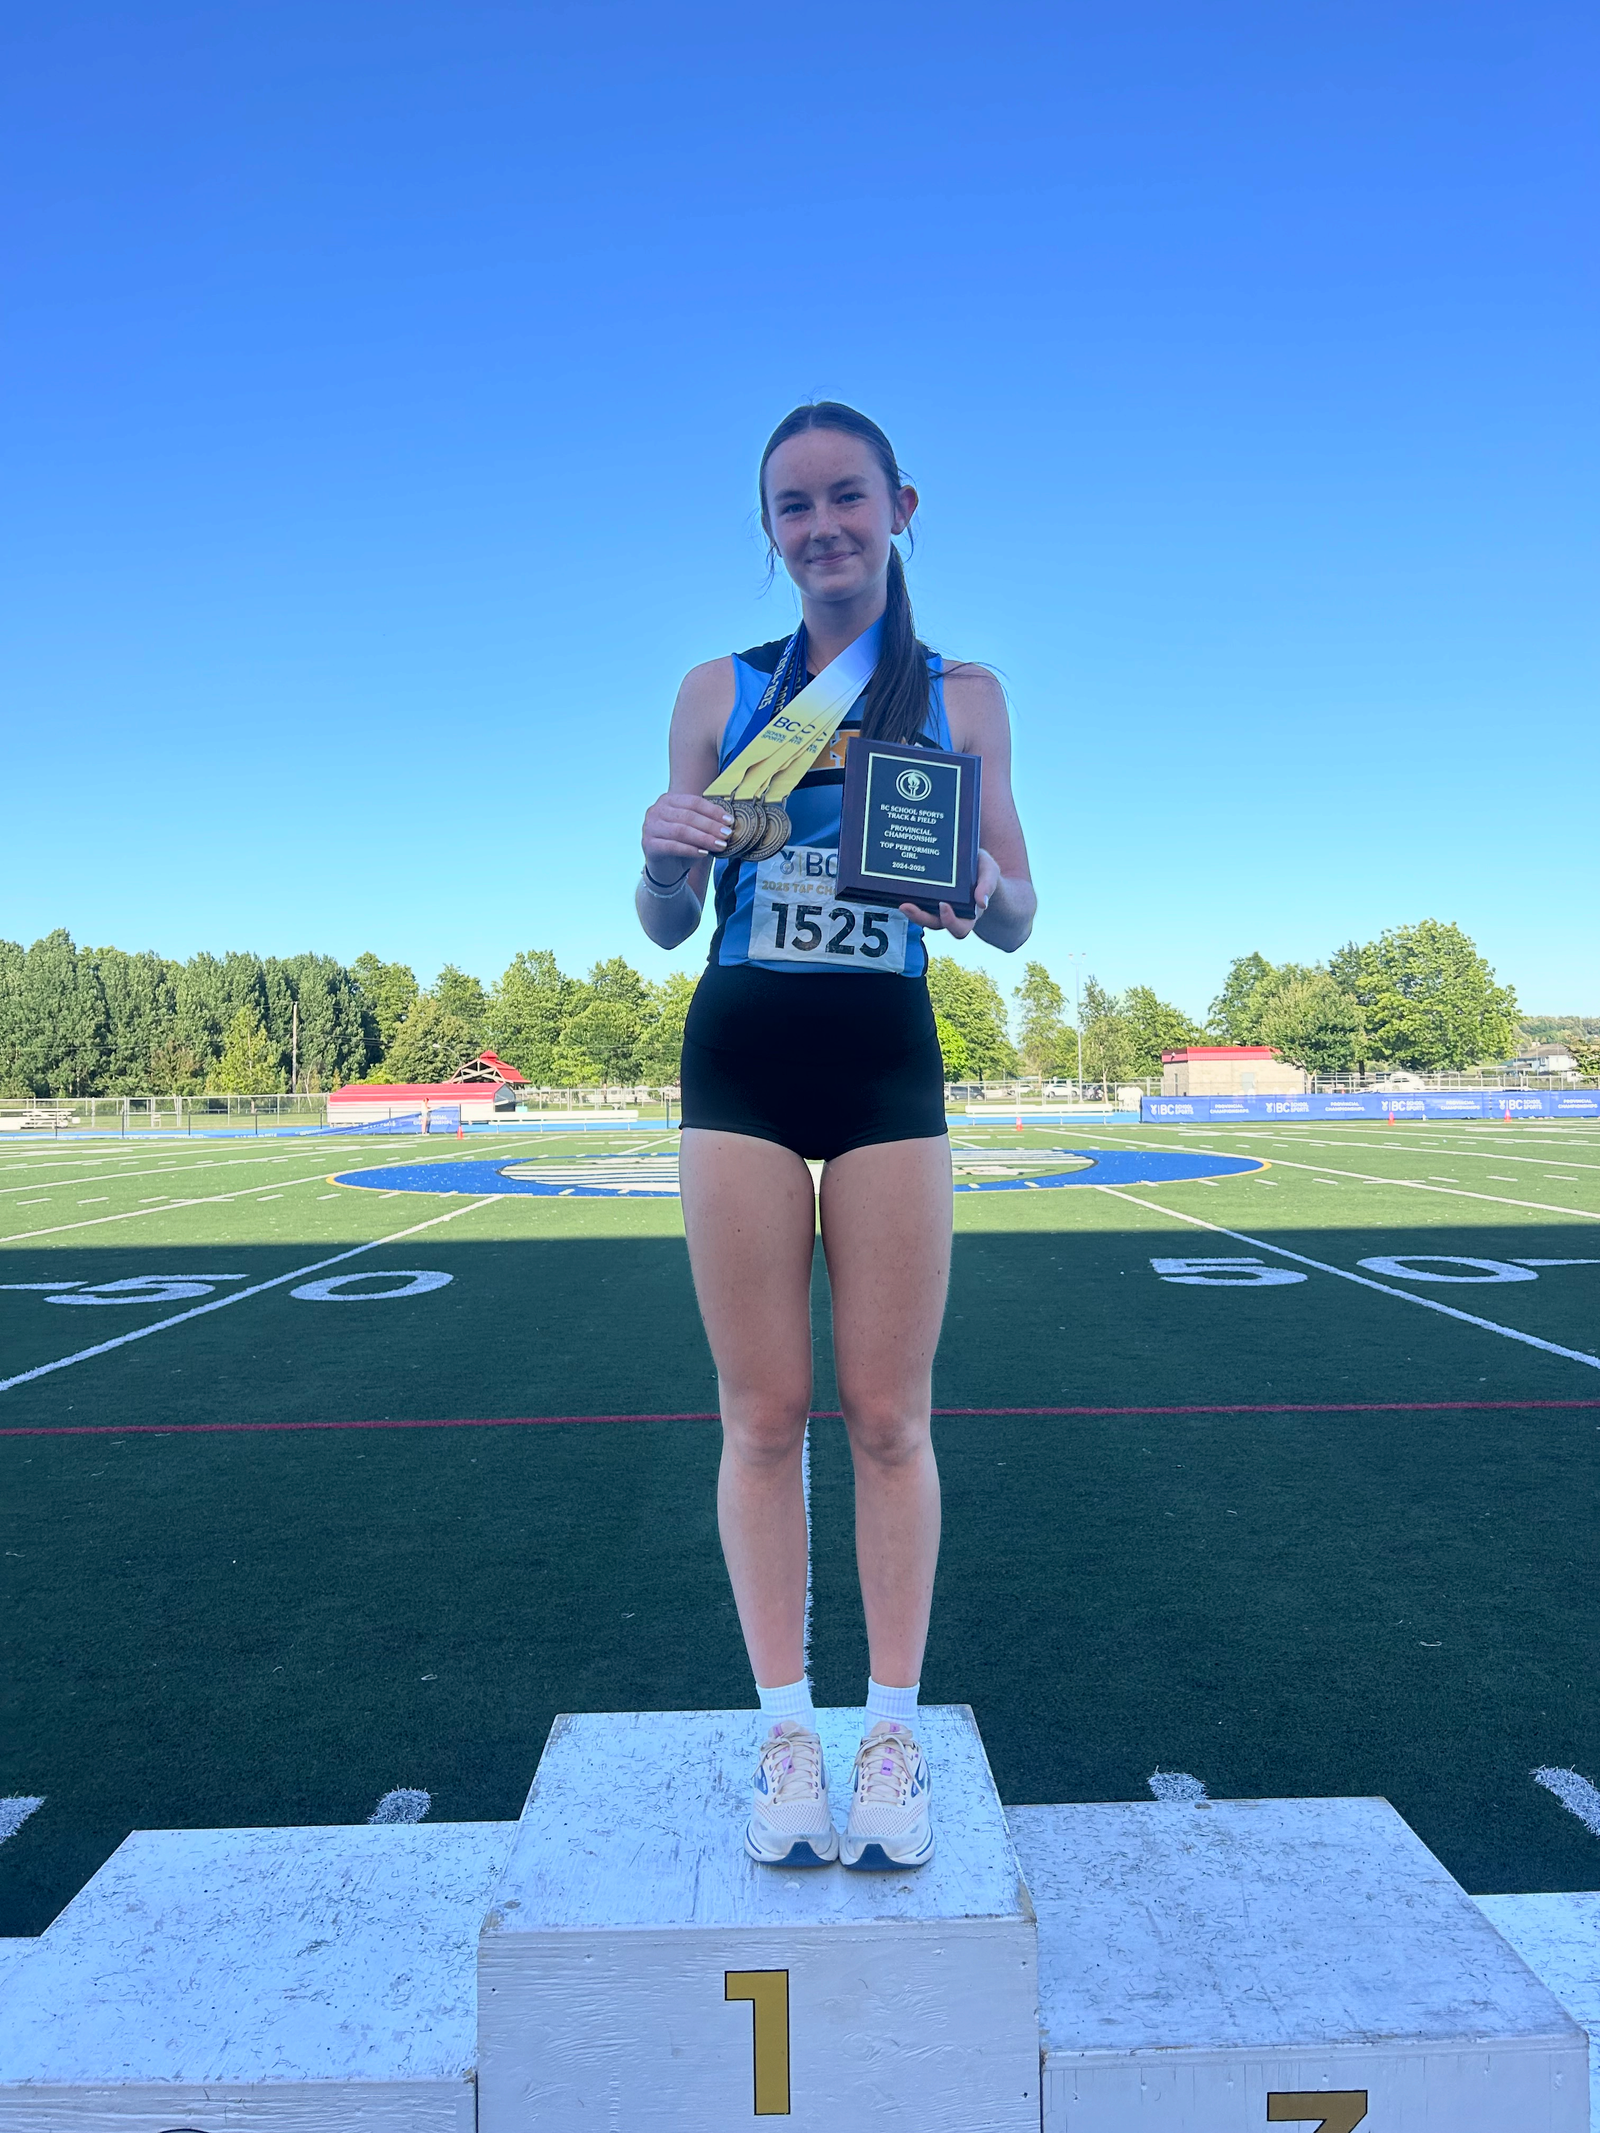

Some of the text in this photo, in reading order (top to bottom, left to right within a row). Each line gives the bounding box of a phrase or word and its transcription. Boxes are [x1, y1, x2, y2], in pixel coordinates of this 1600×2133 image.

[772, 716, 801, 732] BC
[887, 812, 910, 821] TRACK
[917, 816, 937, 825] FIELD
[890, 805, 918, 815] SCHOOL
[918, 809, 944, 819] SPORTS
[890, 824, 932, 836] PROVINCIAL
[884, 830, 938, 844] CHAMPIONSHIP
[880, 841, 940, 856] TOP PERFORMING
[901, 851, 918, 860] GIRL
[892, 861, 926, 872] 2024-2025
[761, 880, 790, 893] 2025
[792, 882, 814, 894] T&F
[771, 902, 889, 958] 1525
[1160, 1104, 1175, 1115] BC
[1276, 1102, 1290, 1113] BC
[1391, 1100, 1406, 1111] BC
[1508, 1099, 1523, 1110] BC
[725, 1969, 790, 2116] 1
